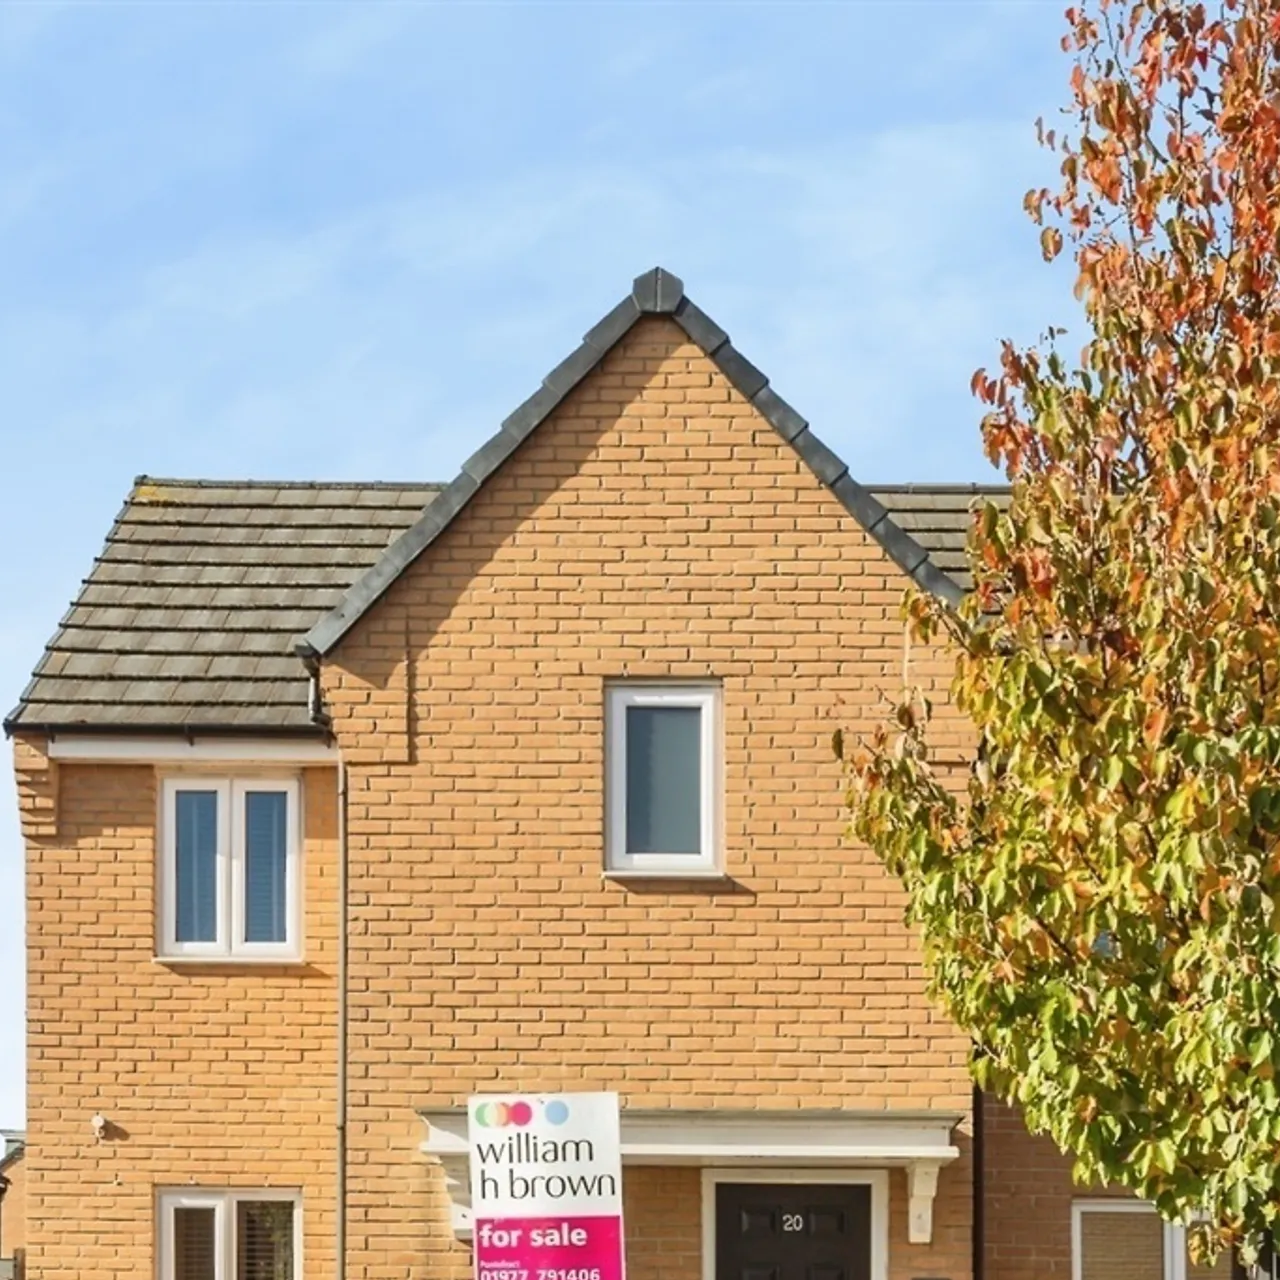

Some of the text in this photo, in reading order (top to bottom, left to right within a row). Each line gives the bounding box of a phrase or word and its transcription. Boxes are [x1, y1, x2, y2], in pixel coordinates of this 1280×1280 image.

[477, 1132, 594, 1164] william
[481, 1168, 616, 1199] h brown
[479, 1222, 587, 1248] for sale
[782, 1214, 804, 1232] 20
